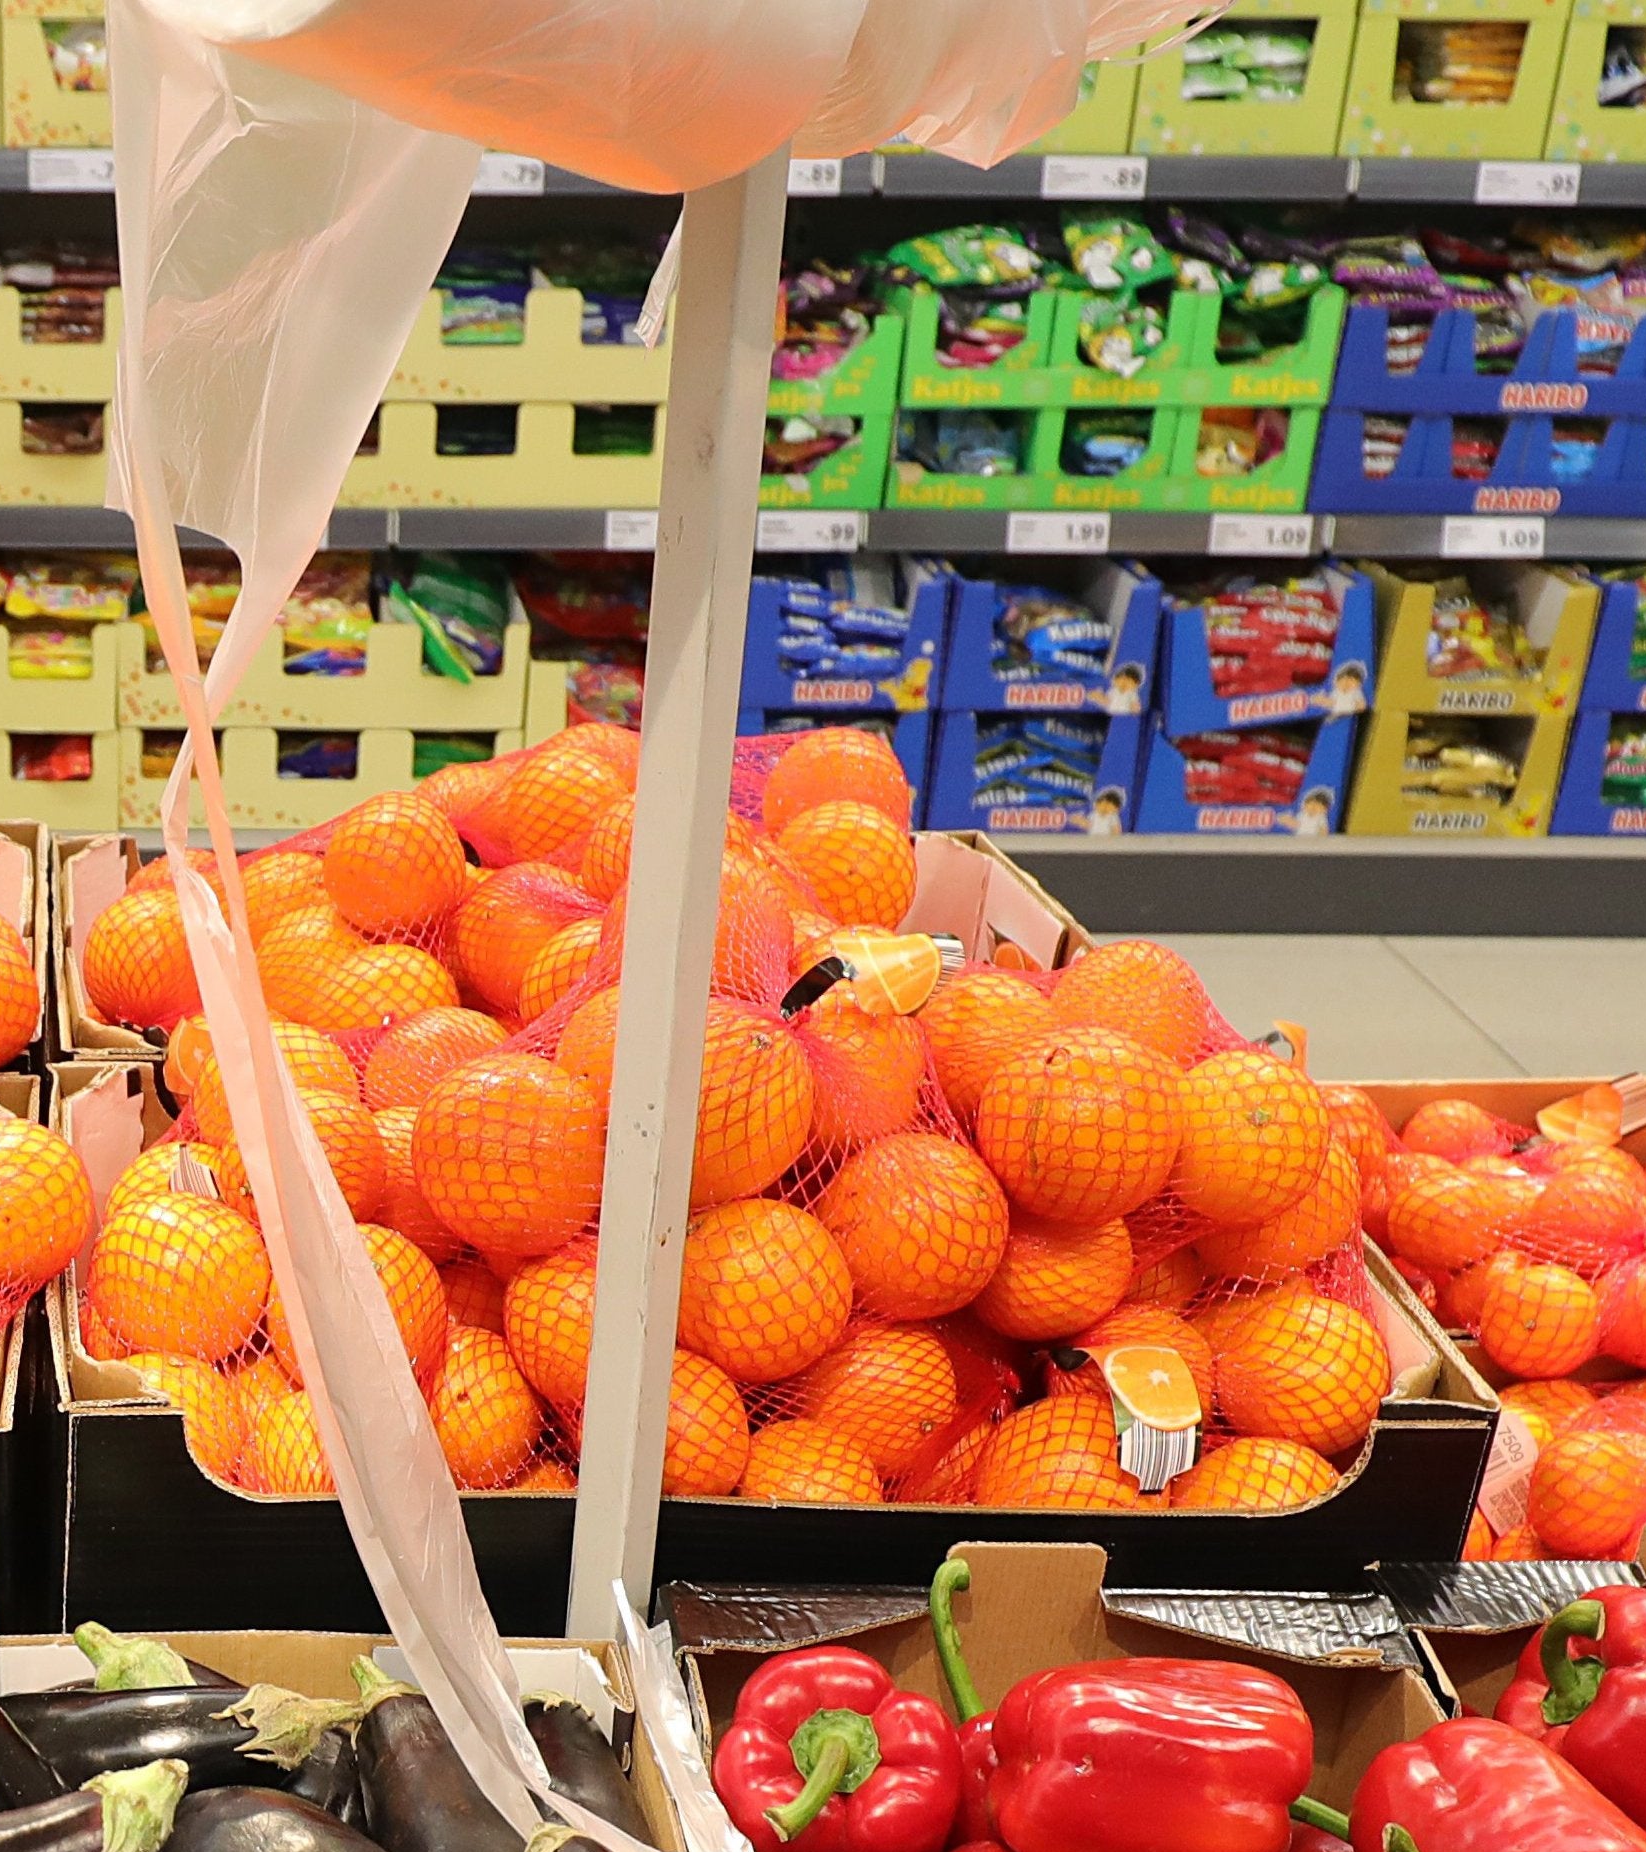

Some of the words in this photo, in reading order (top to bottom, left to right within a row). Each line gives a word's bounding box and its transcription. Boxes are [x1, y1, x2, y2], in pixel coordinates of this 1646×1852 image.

[913, 375, 1001, 401] Katjes
[1071, 375, 1160, 400] Katjes
[1231, 374, 1320, 399] Katjes
[1502, 384, 1588, 409] HARIBO
[768, 391, 823, 412] atjes
[897, 480, 985, 506] Katjes
[1054, 481, 1141, 506] Katjes
[1209, 480, 1296, 506] Katjes
[1474, 488, 1561, 511] HARIBO
[794, 681, 872, 703] HARIBO
[1007, 684, 1086, 707] HARIBO
[1439, 690, 1514, 710] HARIBO
[1230, 695, 1306, 722] HARIBO
[990, 808, 1067, 829] HARIBO
[1198, 808, 1276, 829] HARIBO
[1414, 811, 1487, 830] HARIBO
[1497, 1424, 1526, 1464] 750g
